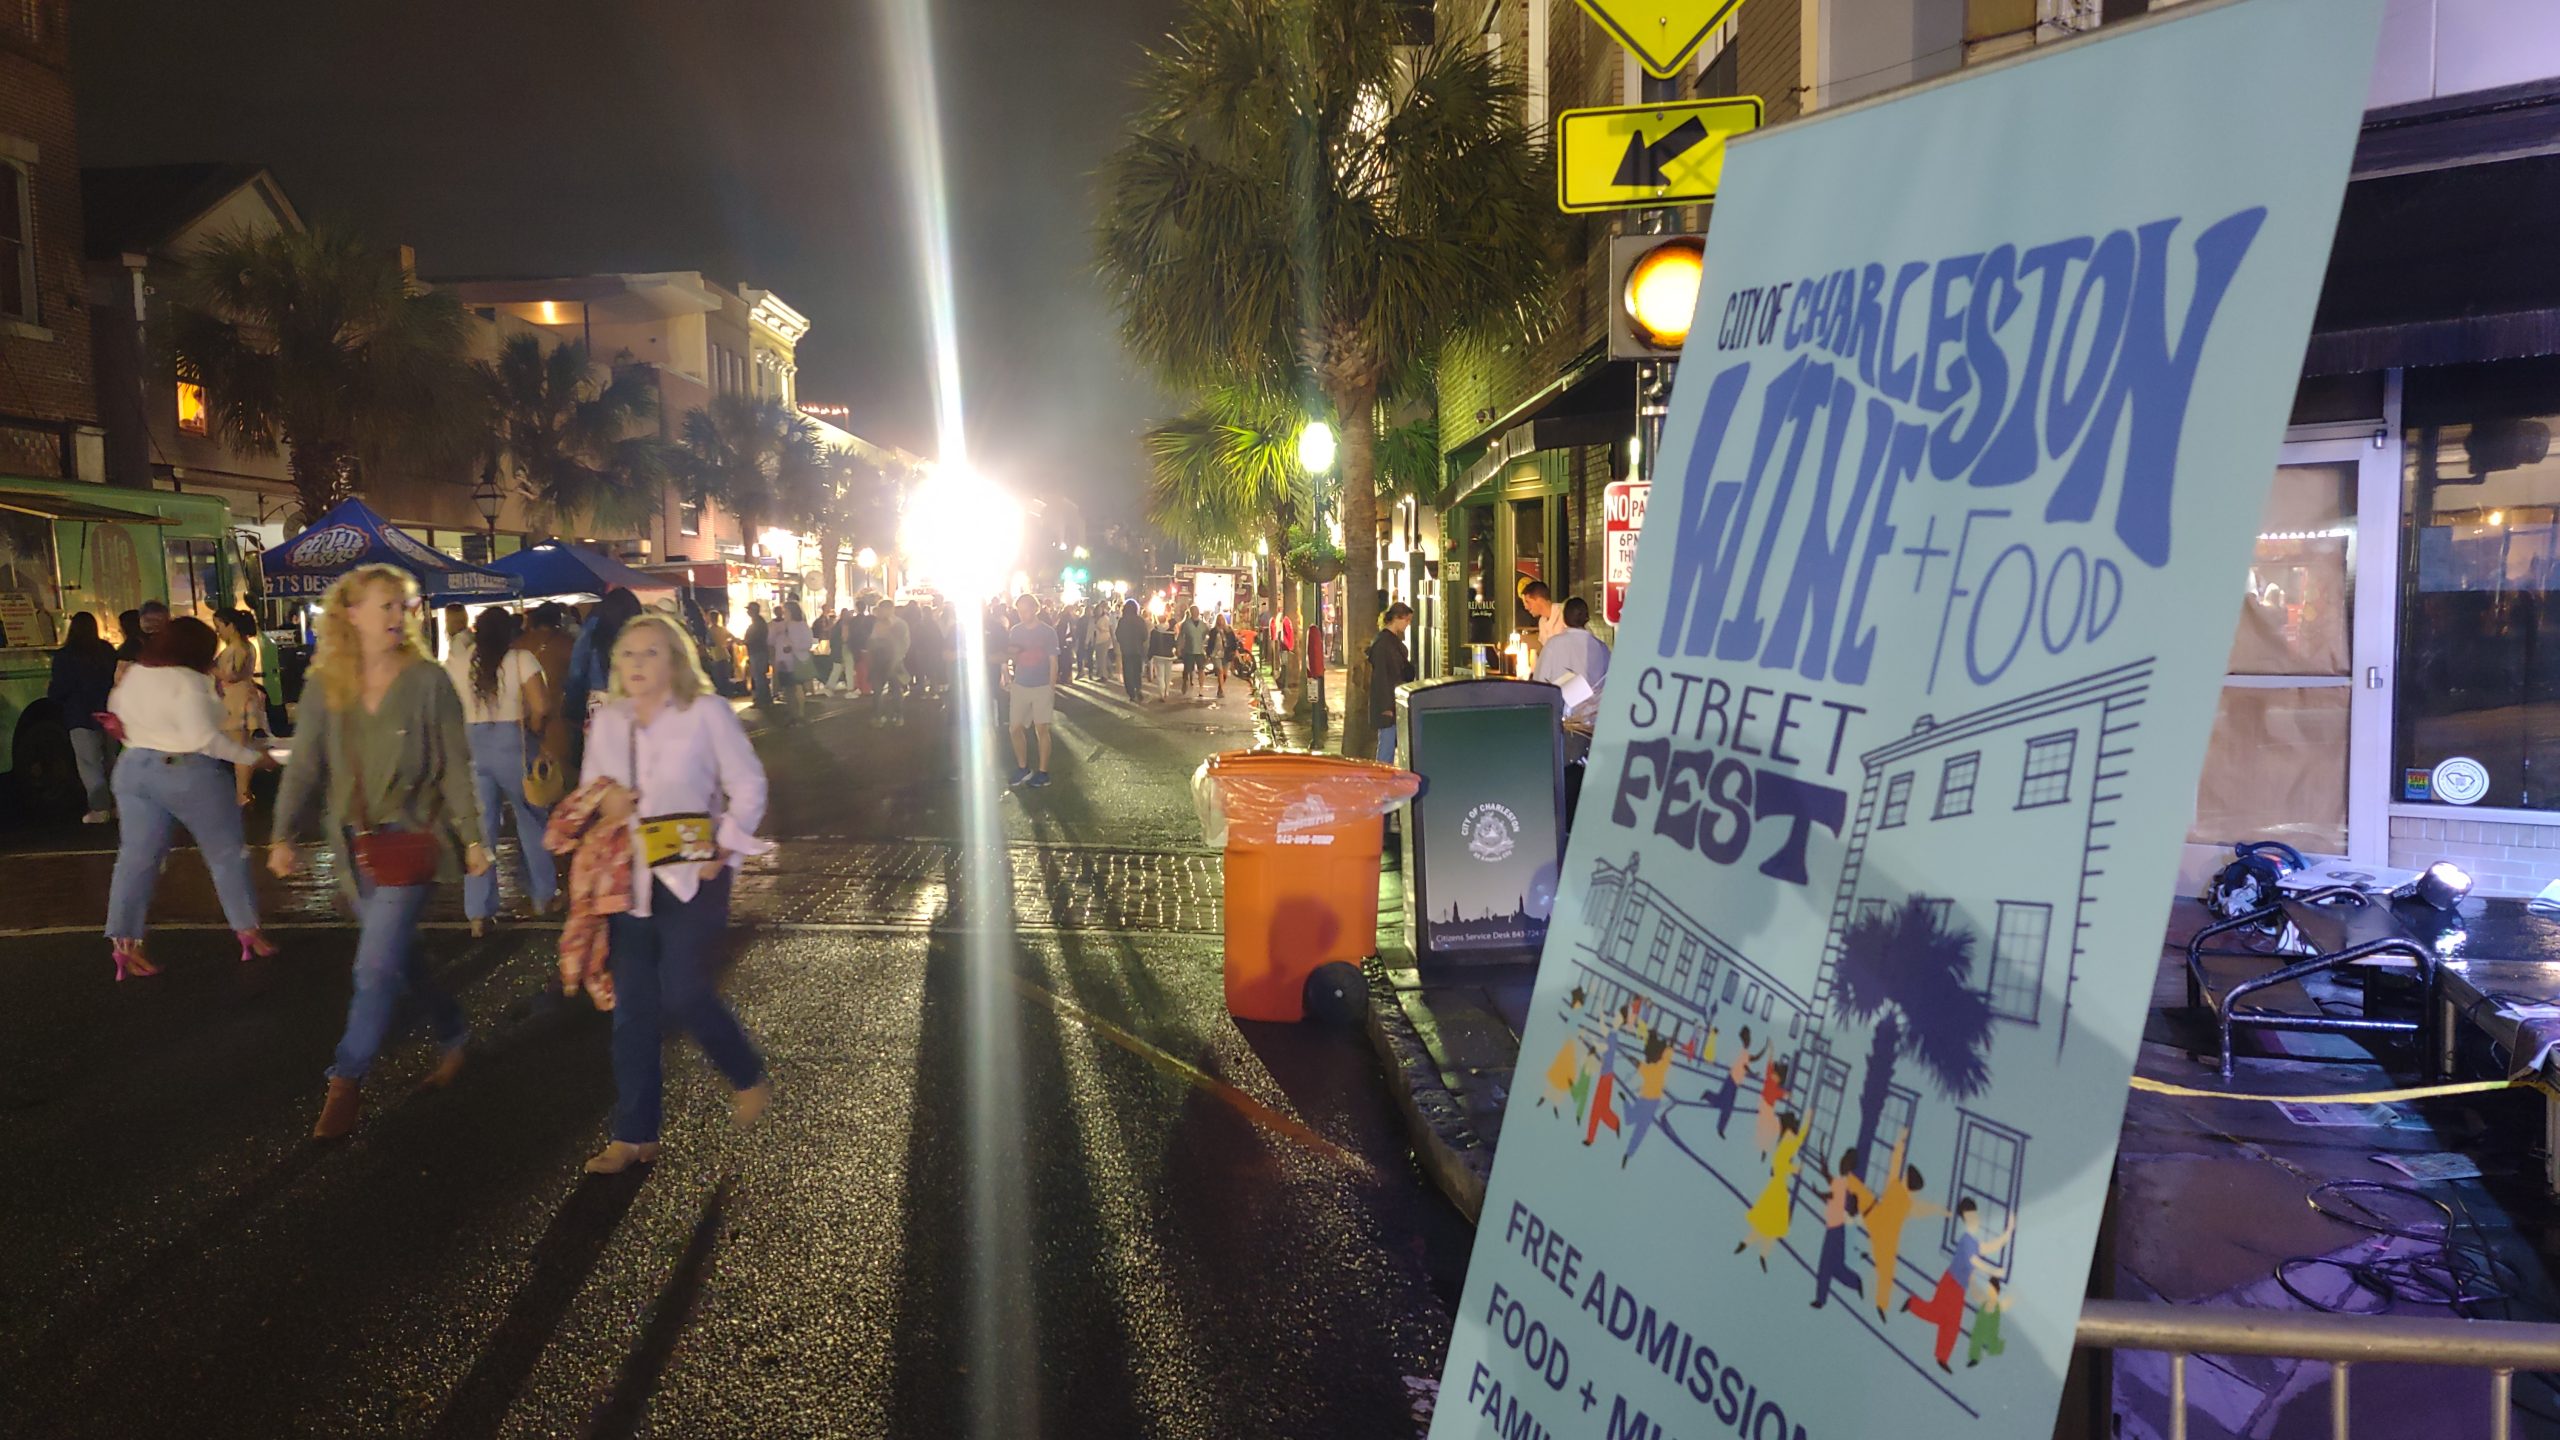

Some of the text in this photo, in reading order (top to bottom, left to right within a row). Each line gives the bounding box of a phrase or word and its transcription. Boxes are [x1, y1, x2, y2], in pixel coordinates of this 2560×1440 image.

[1718, 206, 2268, 568] CITY OF CHARLESTON
[1607, 494, 1646, 521] NO PA
[1658, 352, 1929, 686] WINE
[278, 575, 300, 593] T'S
[1629, 667, 1868, 775] STREET
[1461, 802, 1520, 836] CITY OF CHARLESTON
[1611, 737, 1848, 886] FEST
[1435, 934, 1464, 943] Citizens
[1465, 932, 1491, 941] Service
[1492, 931, 1511, 939] Desk
[1506, 1200, 1583, 1299] FREE
[1486, 1282, 1570, 1392] FOOD
[1579, 1380, 1598, 1413] +
